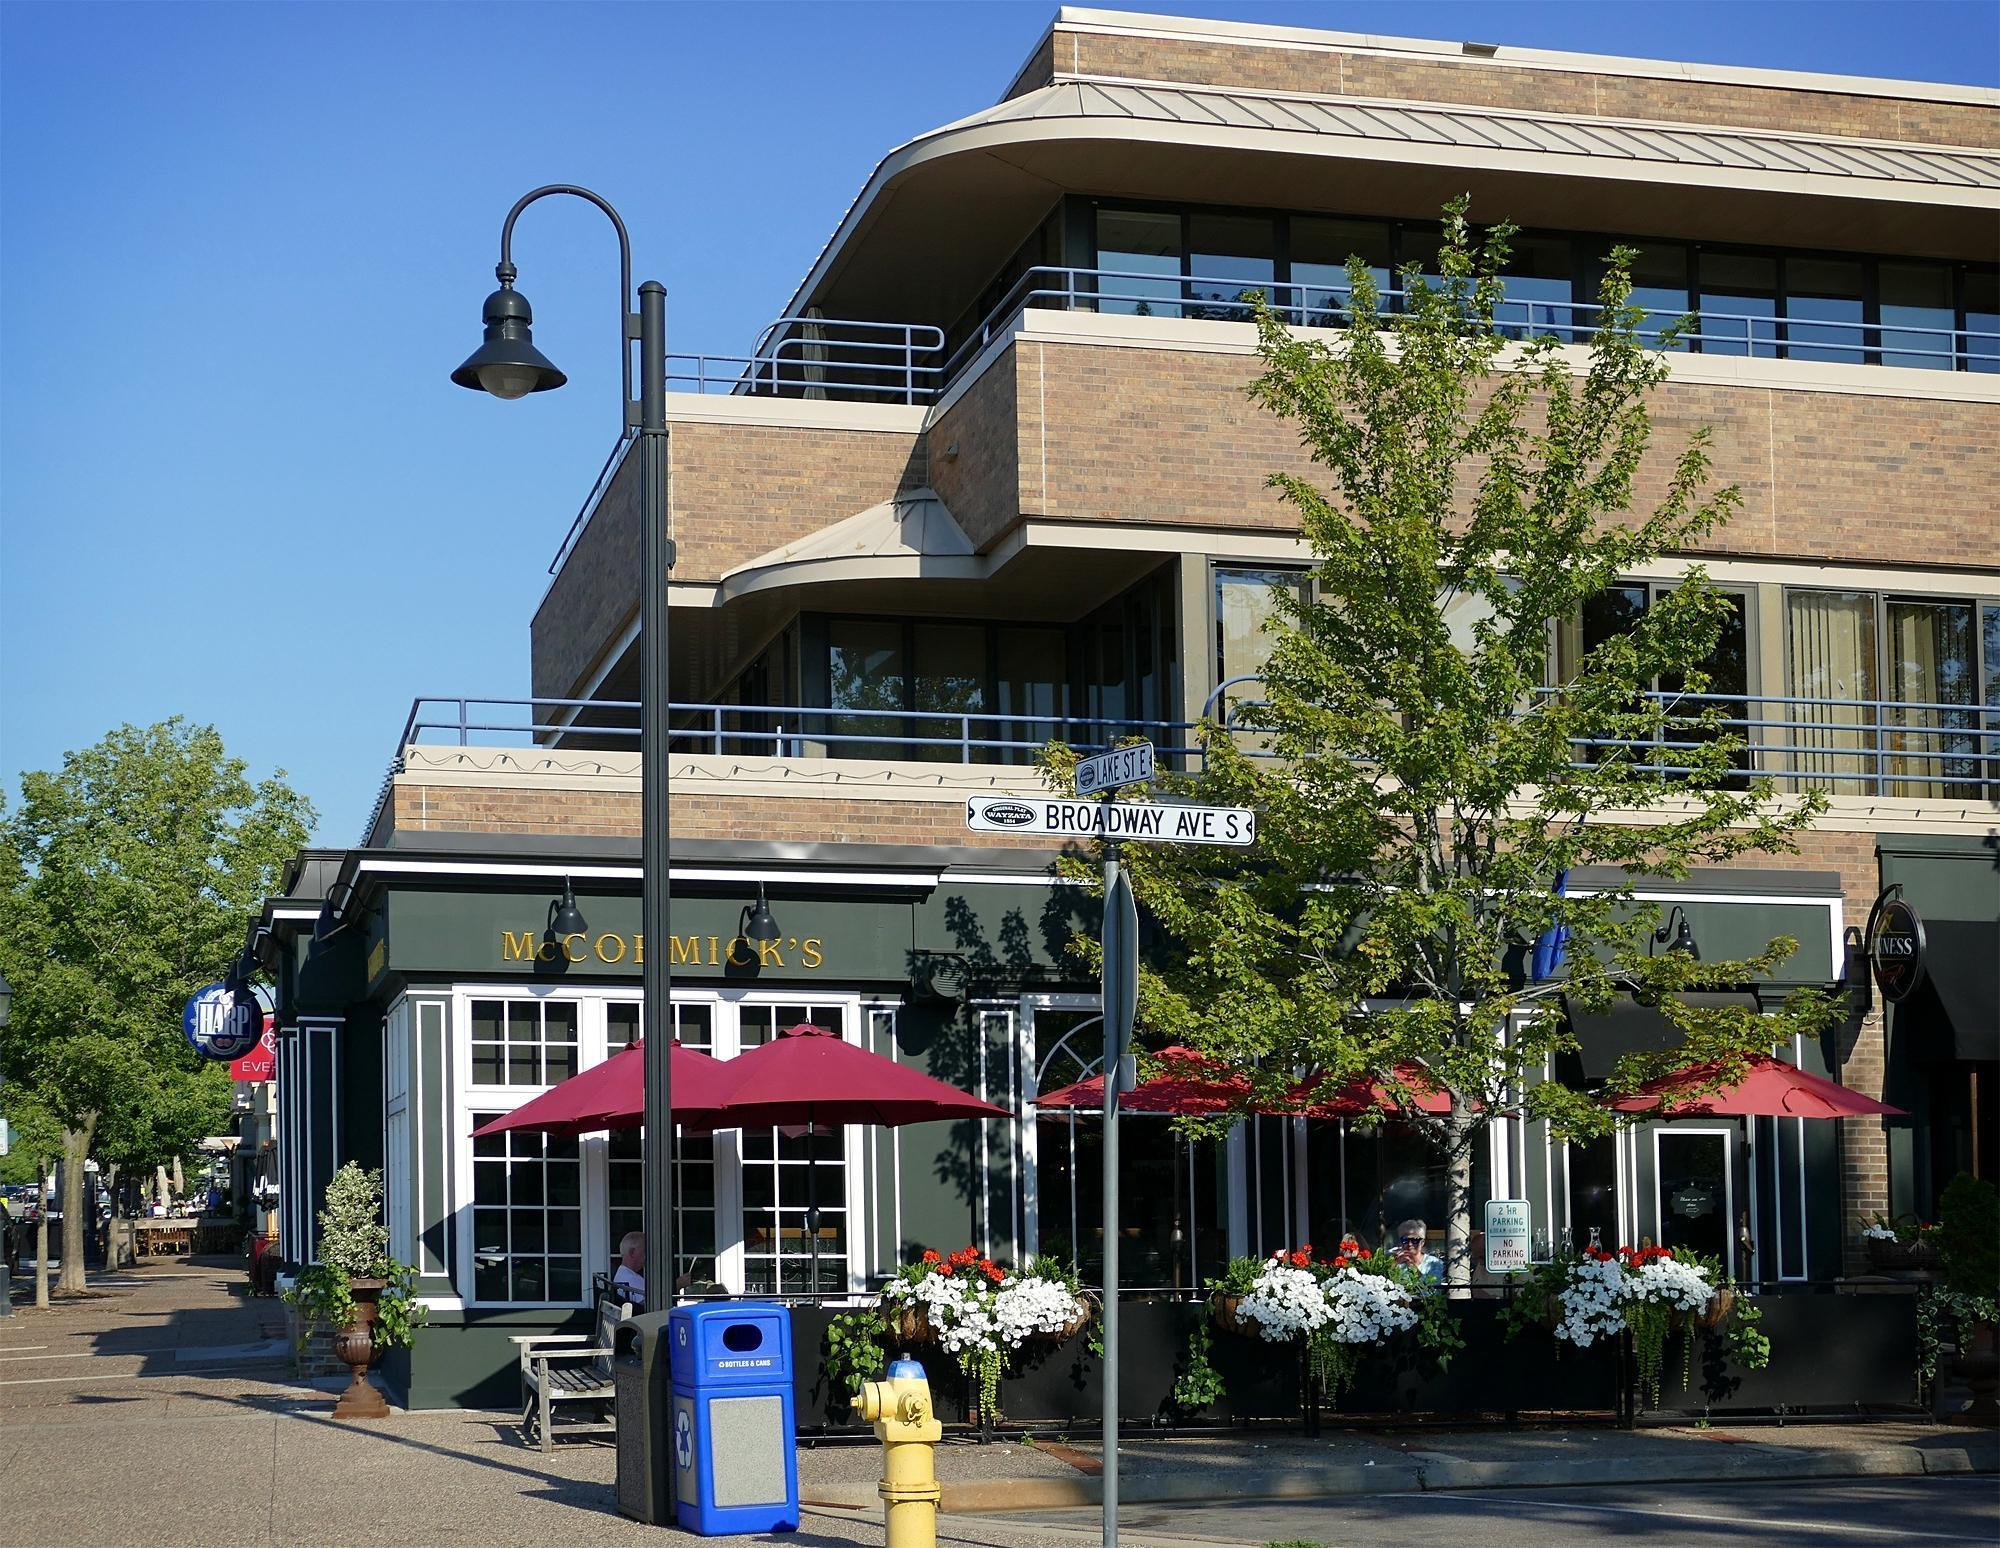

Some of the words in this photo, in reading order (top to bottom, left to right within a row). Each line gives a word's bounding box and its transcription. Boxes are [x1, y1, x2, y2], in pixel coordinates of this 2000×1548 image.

[1096, 756, 1119, 786] LAKE
[1123, 752, 1136, 779] ST
[1140, 749, 1147, 776] E
[986, 811, 1032, 820] WAYZATA
[1046, 804, 1164, 835] BROADWAY
[1176, 811, 1215, 838] AVE
[1225, 813, 1239, 839] S
[199, 1003, 249, 1035] HARP
[1498, 1206, 1504, 1216] 2
[1507, 1206, 1518, 1215] HR
[1492, 1217, 1524, 1226] PARKING
[1503, 1239, 1514, 1248] NO
[1492, 1249, 1524, 1258] PARKING
[725, 1360, 750, 1368] BOTTLES
